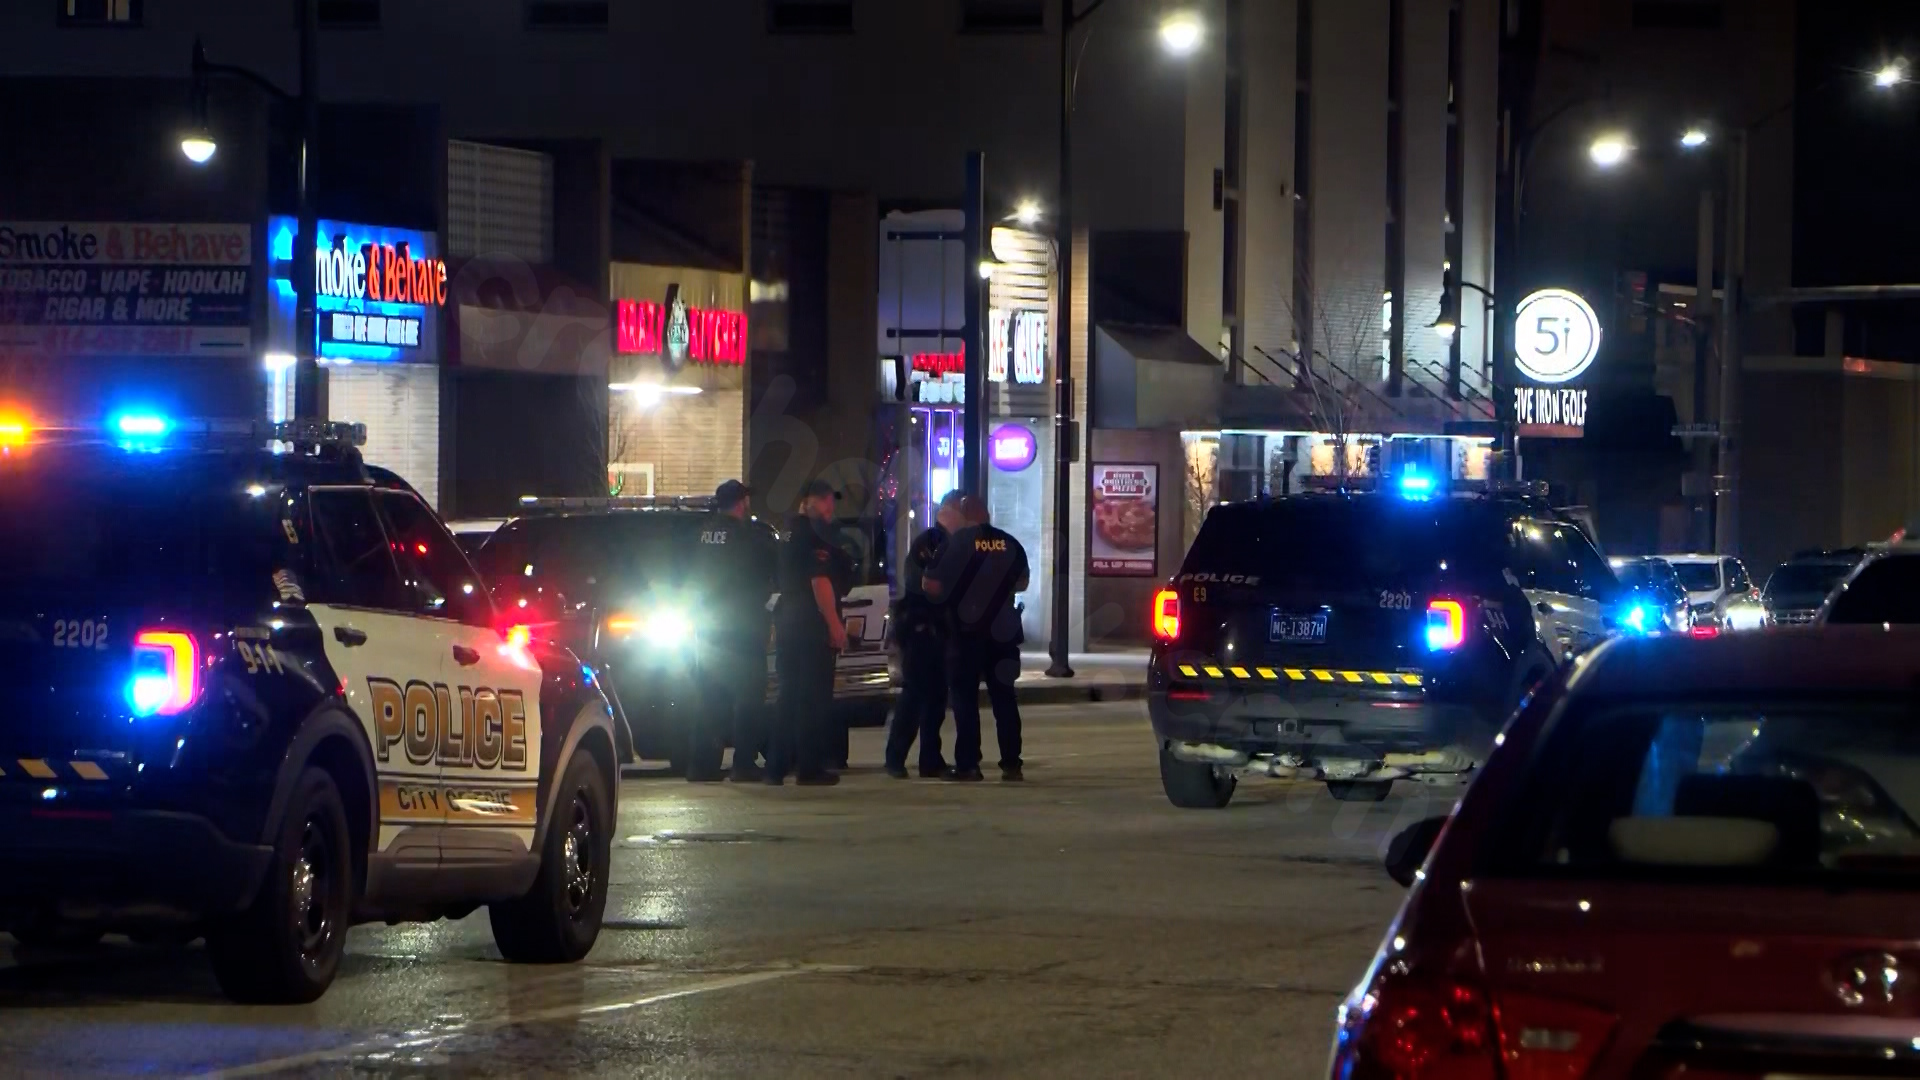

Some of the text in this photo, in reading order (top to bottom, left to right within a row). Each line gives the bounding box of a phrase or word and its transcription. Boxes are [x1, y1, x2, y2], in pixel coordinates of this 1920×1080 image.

[0, 224, 244, 261] Smoke & Behave
[100, 269, 152, 294] VAPE
[163, 270, 247, 295] HOOKAH
[316, 236, 447, 306] moke & Behave
[111, 297, 129, 321] &
[135, 298, 193, 321] MORE
[1536, 388, 1560, 424] IRON
[1560, 388, 1588, 426] GOLF
[975, 539, 1008, 552] POLICE
[1180, 572, 1263, 587] POLICE
[53, 618, 109, 651] 2202
[366, 675, 527, 771] POLICE
[397, 785, 440, 811] CITY
